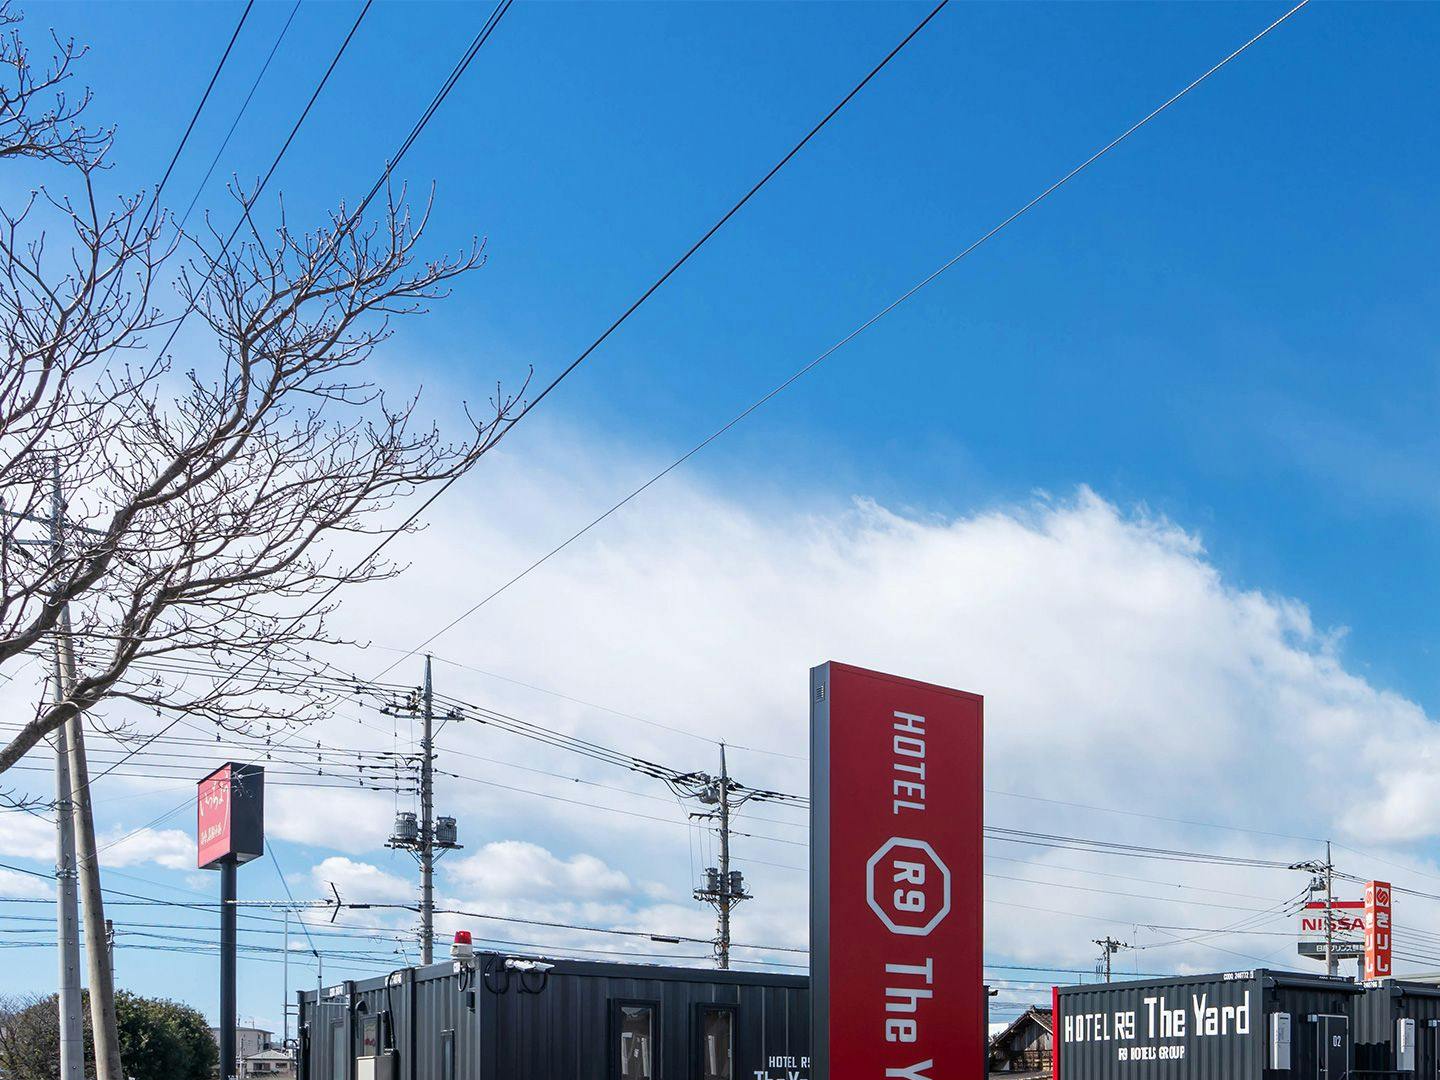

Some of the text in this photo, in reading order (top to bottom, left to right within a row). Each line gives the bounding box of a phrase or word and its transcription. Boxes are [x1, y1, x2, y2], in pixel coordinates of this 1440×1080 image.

[893, 711, 926, 815] HOTEL
[893, 860, 926, 913] R9
[1302, 917, 1365, 931] NISSA
[885, 957, 933, 1043] The
[1064, 991, 1250, 1042] HOTEL R9 The Yard
[1158, 1045, 1185, 1060] GROUP
[1332, 1035, 1342, 1047] 02
[768, 1056, 797, 1068] HOTEL
